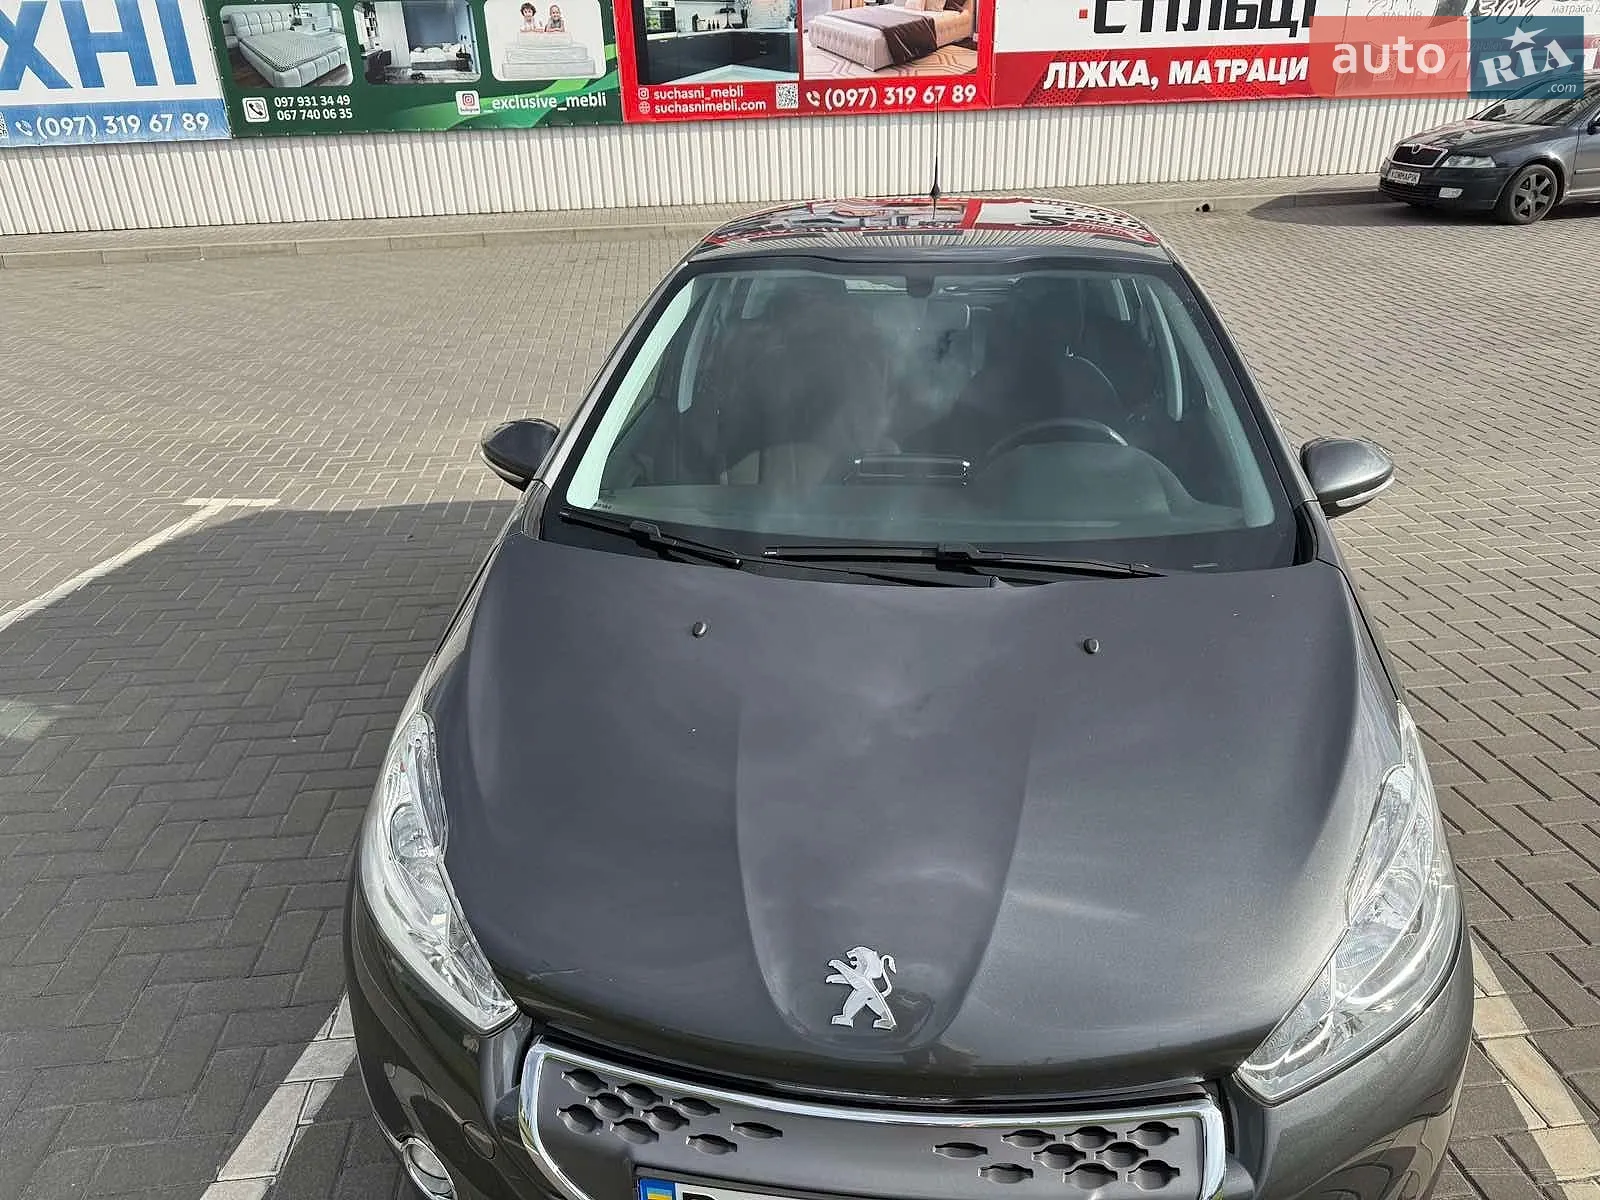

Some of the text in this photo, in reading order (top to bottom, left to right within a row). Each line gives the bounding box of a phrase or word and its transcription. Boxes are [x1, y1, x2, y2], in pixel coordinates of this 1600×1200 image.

[1044, 57, 1309, 90] ЛІЖКА, МАТРАЦИ
[654, 85, 745, 101] suchasni_mebli
[825, 84, 977, 110] (097) 319 67 89
[274, 95, 351, 108] 097 931 34 49
[655, 99, 766, 114] suchasnimebli.com
[277, 108, 353, 121] 067 740 06 35
[36, 112, 210, 140] (097) 319 67 89
